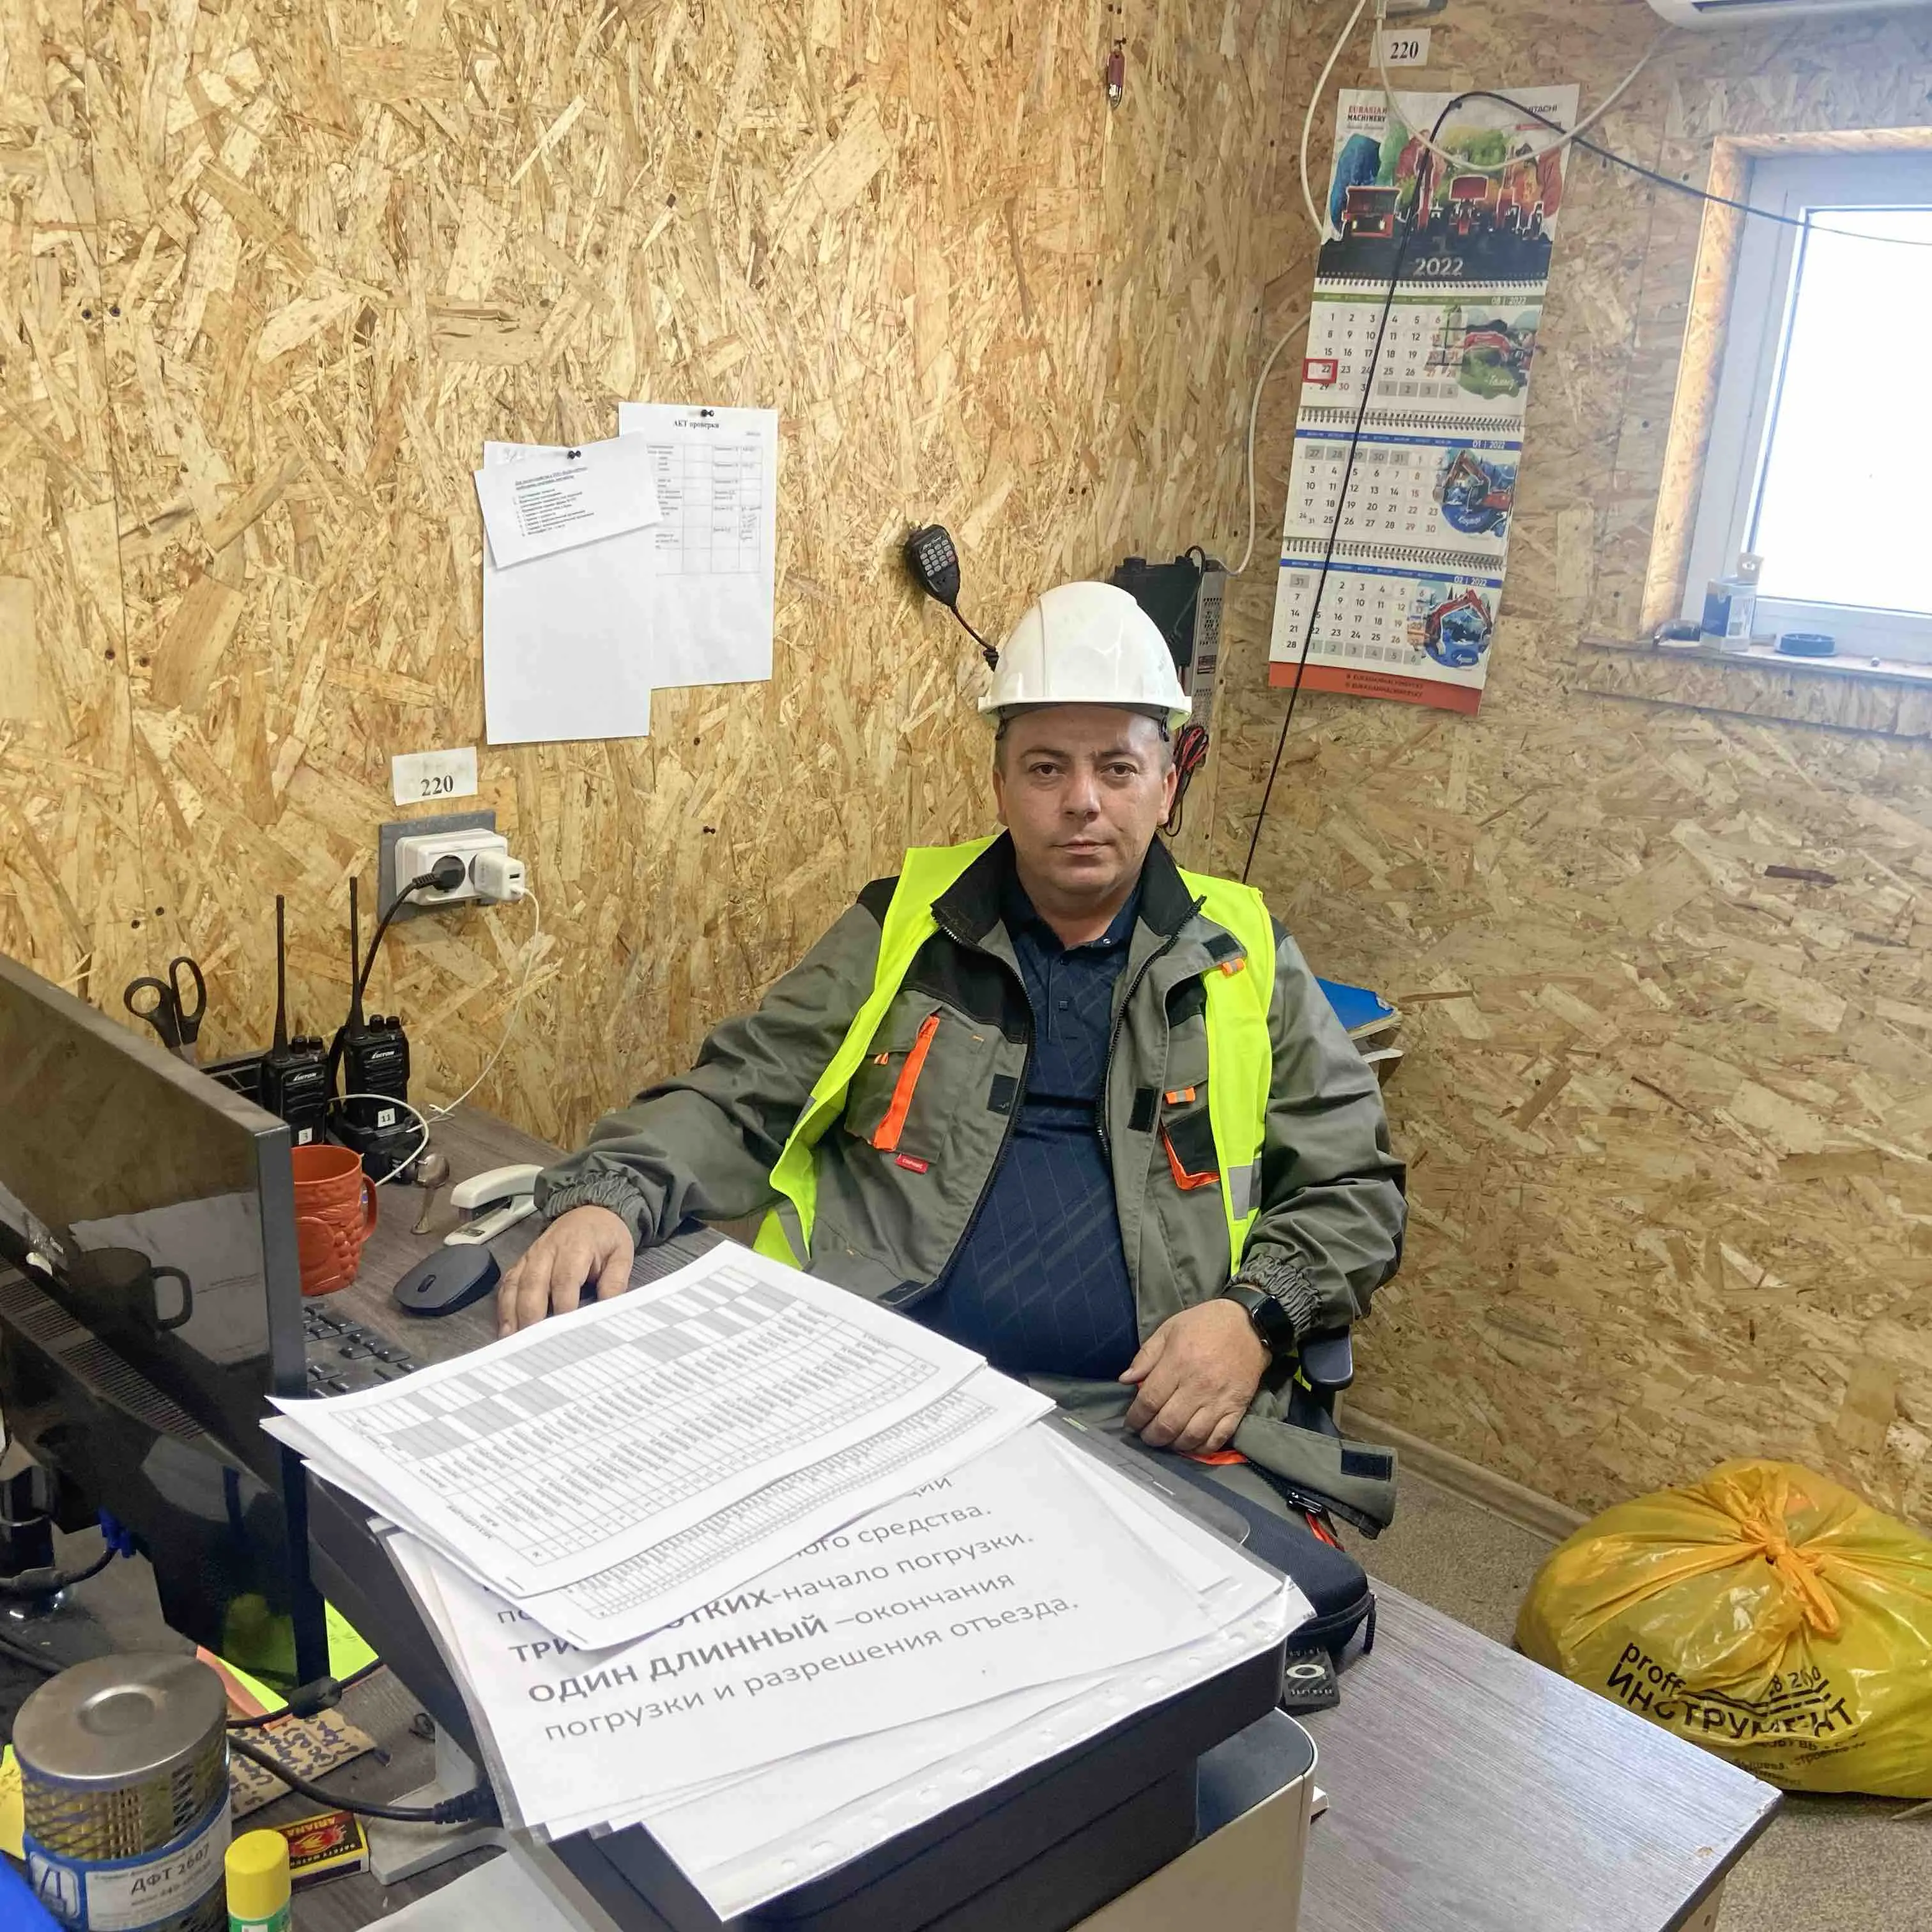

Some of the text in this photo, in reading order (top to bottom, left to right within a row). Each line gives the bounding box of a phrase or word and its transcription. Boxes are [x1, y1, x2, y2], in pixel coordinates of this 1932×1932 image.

[1390, 41, 1419, 60] 220
[1413, 257, 1463, 276] 2022
[1370, 314, 1375, 323] 3
[1366, 332, 1375, 340] 10
[1412, 332, 1420, 341] 12
[1324, 348, 1332, 356] 15
[1344, 348, 1352, 356] 16
[1322, 365, 1331, 373] 22
[1341, 365, 1351, 374] 23
[674, 420, 688, 428] АКТ
[1331, 466, 1337, 475] 4
[1350, 484, 1359, 492] 12
[1390, 487, 1399, 496] 14
[1407, 506, 1418, 514] 22
[1428, 507, 1438, 516] 23
[1344, 517, 1354, 525] 26
[1385, 521, 1395, 529] 28
[1406, 523, 1416, 531] 29
[1354, 615, 1362, 623] 17
[1287, 640, 1296, 648] 28
[1351, 631, 1360, 639] 24
[1390, 636, 1400, 644] 26
[420, 774, 454, 797] 220
[857, 1505, 992, 1544] средства.
[896, 1533, 1034, 1575] погрузки.
[528, 1664, 639, 1704] ОДИН
[649, 1614, 829, 1682] ДЛИННЫЙ
[544, 1597, 1080, 1742] погрузки и разрешения отъезда.
[1620, 1642, 1687, 1697] proff
[286, 1816, 336, 1837] ARIANA
[290, 1853, 321, 1867] MATCH
[131, 1867, 172, 1896] ДФТ
